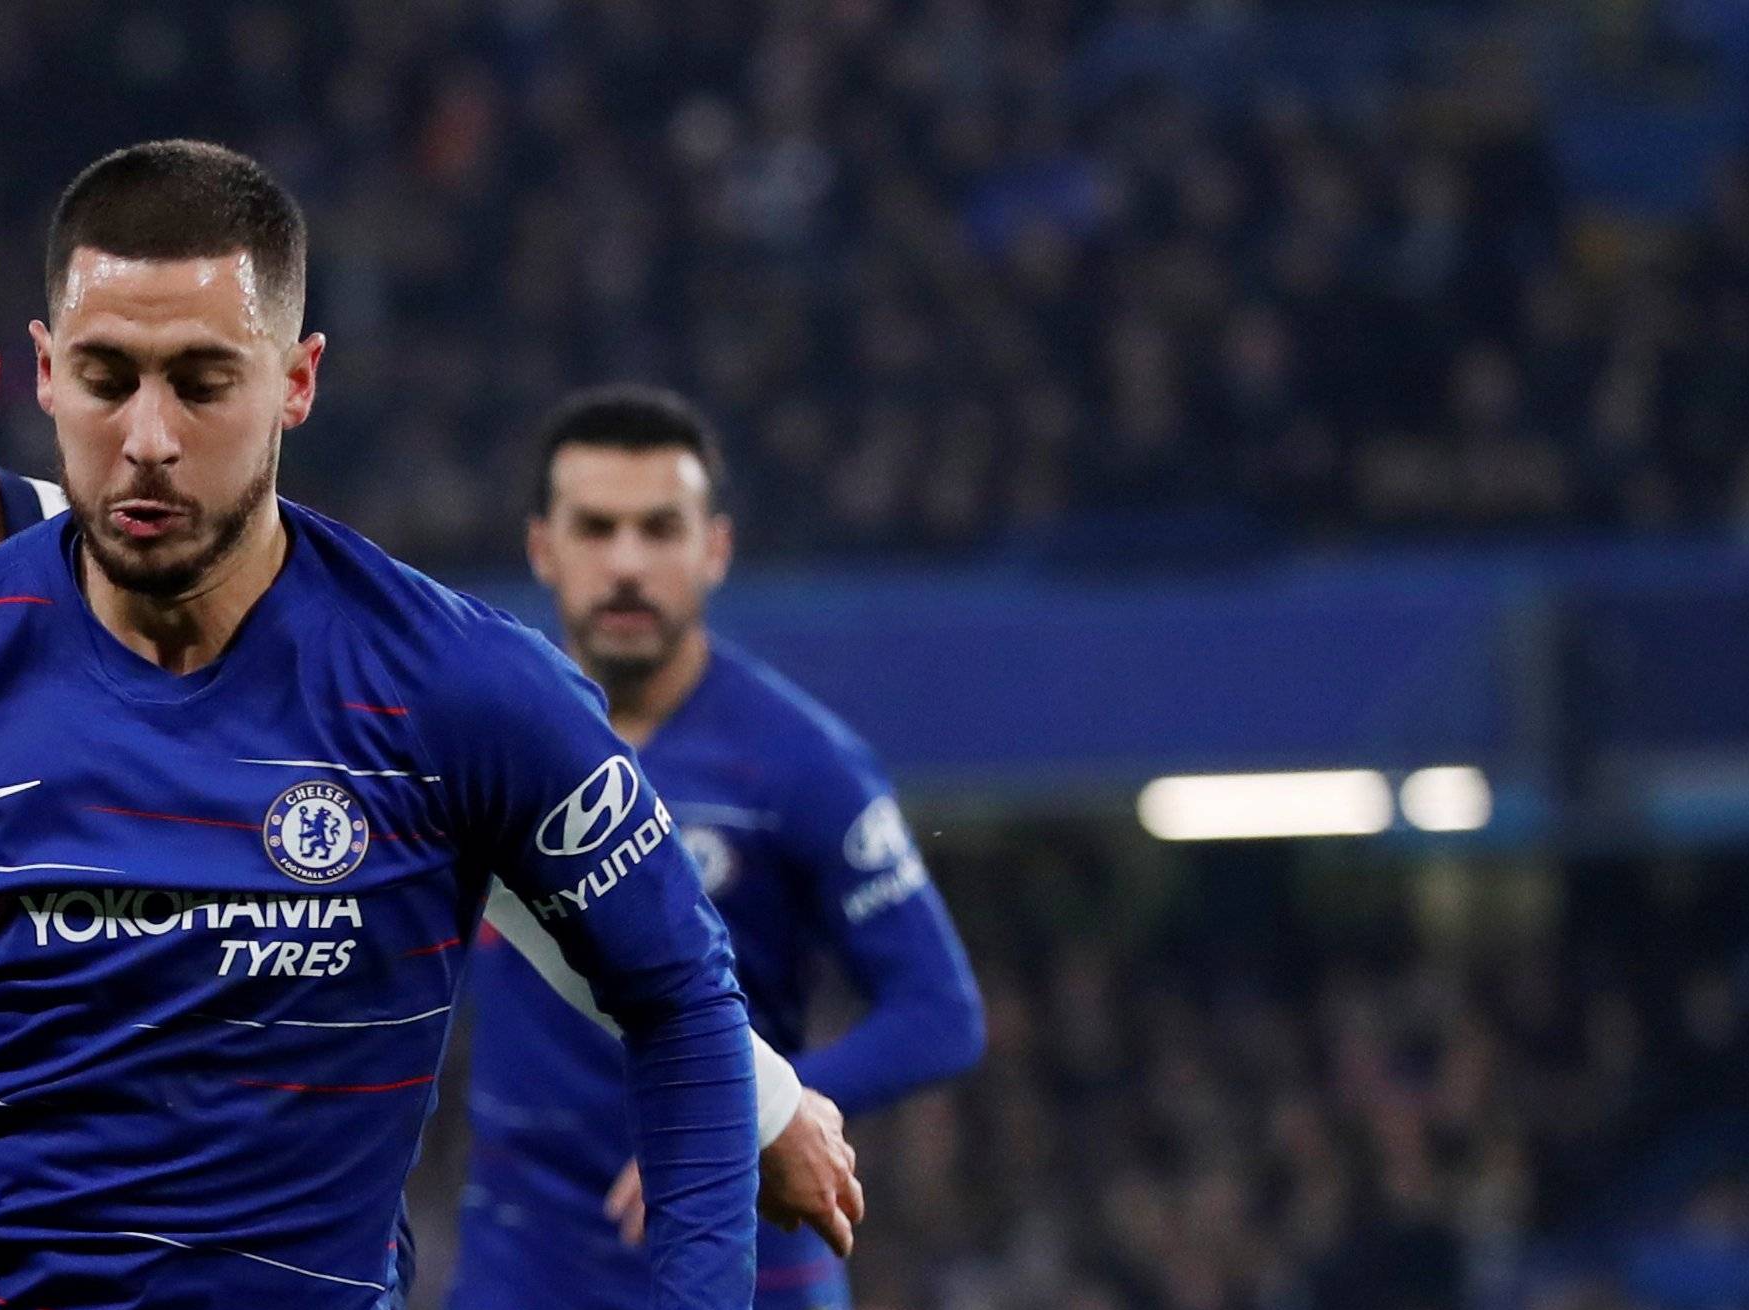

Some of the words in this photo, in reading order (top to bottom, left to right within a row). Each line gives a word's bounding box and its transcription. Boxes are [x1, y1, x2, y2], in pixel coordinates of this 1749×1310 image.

[285, 786, 351, 810] CHELSEA
[280, 858, 324, 879] FOOTBALL
[326, 862, 349, 877] CLUB
[532, 796, 672, 920] HYUNDA
[19, 888, 363, 946] YOKOHAMA
[217, 938, 358, 978] TYRES
